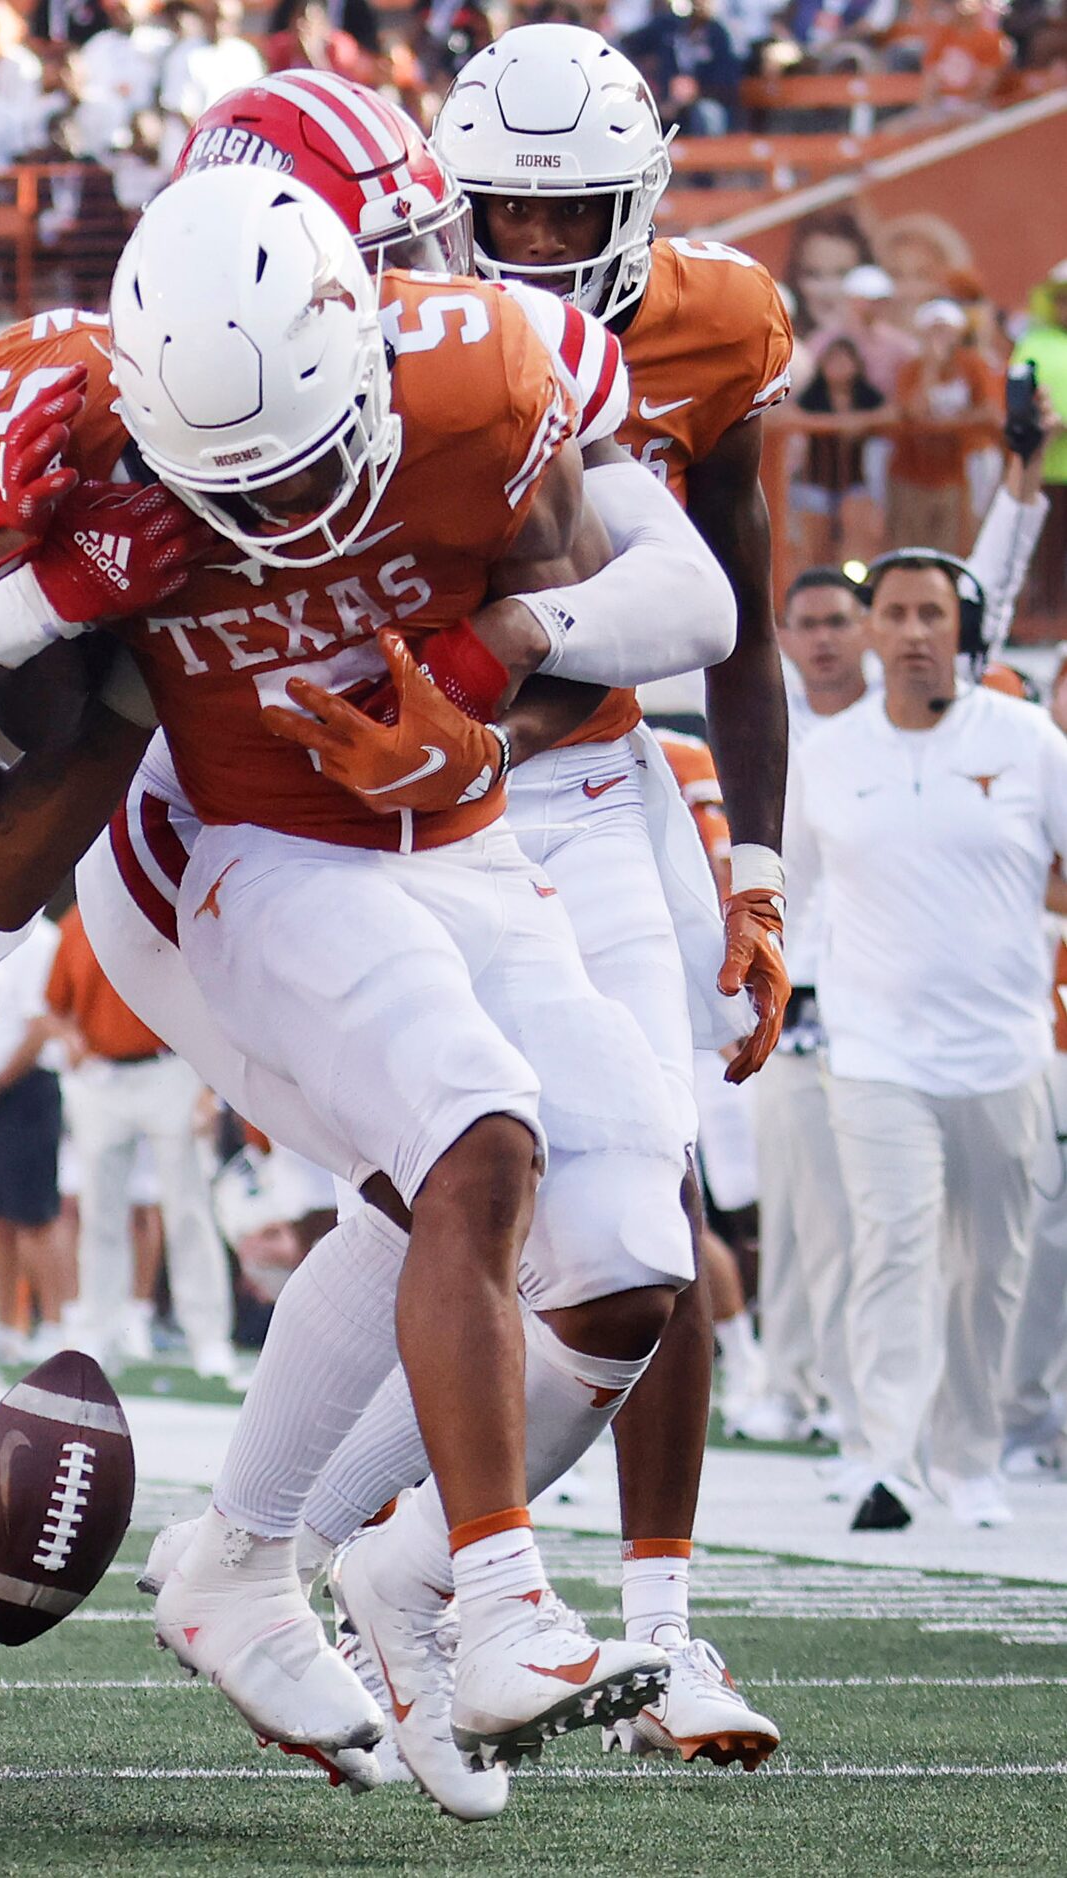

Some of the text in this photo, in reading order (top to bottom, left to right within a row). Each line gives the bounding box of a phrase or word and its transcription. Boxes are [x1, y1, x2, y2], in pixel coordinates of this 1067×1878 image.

[515, 153, 562, 169] HORNS
[376, 293, 491, 356] 5
[212, 445, 263, 468] HORNS
[73, 531, 131, 591] adidas
[146, 553, 433, 676] TEXAS
